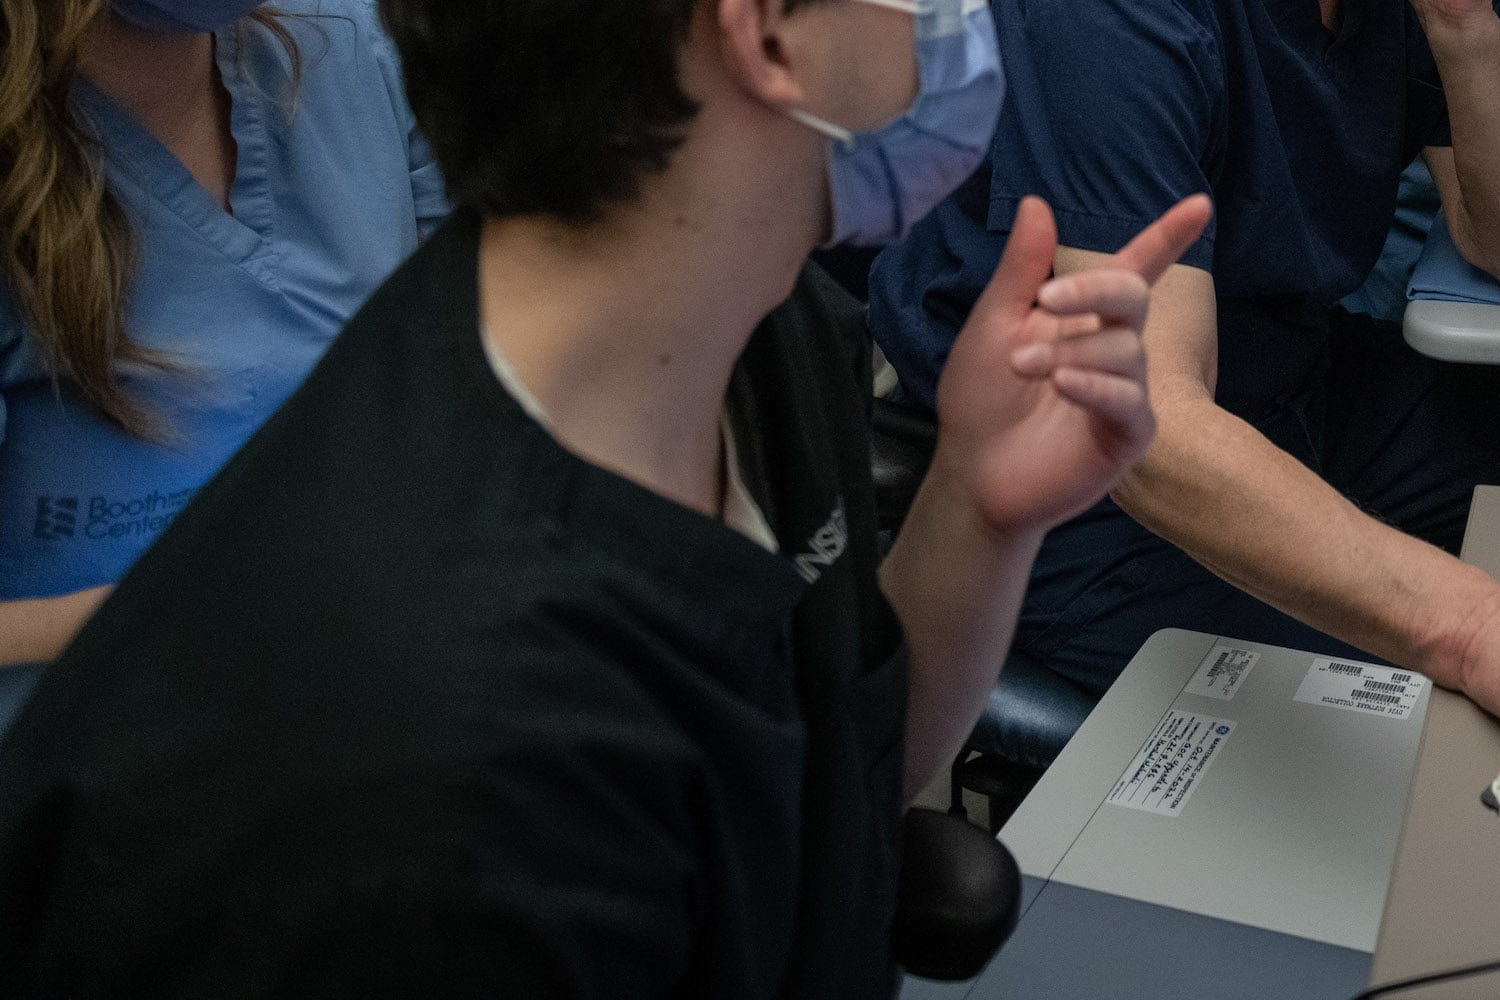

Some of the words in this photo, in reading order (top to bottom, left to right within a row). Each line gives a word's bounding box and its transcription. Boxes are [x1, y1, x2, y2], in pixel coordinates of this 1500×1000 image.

[1321, 696, 1354, 706] COLLECTOR
[1355, 702, 1385, 712] SOFTWARE
[1196, 737, 1221, 773] MAINTENANCE
[1170, 778, 1195, 809] INSPECTION
